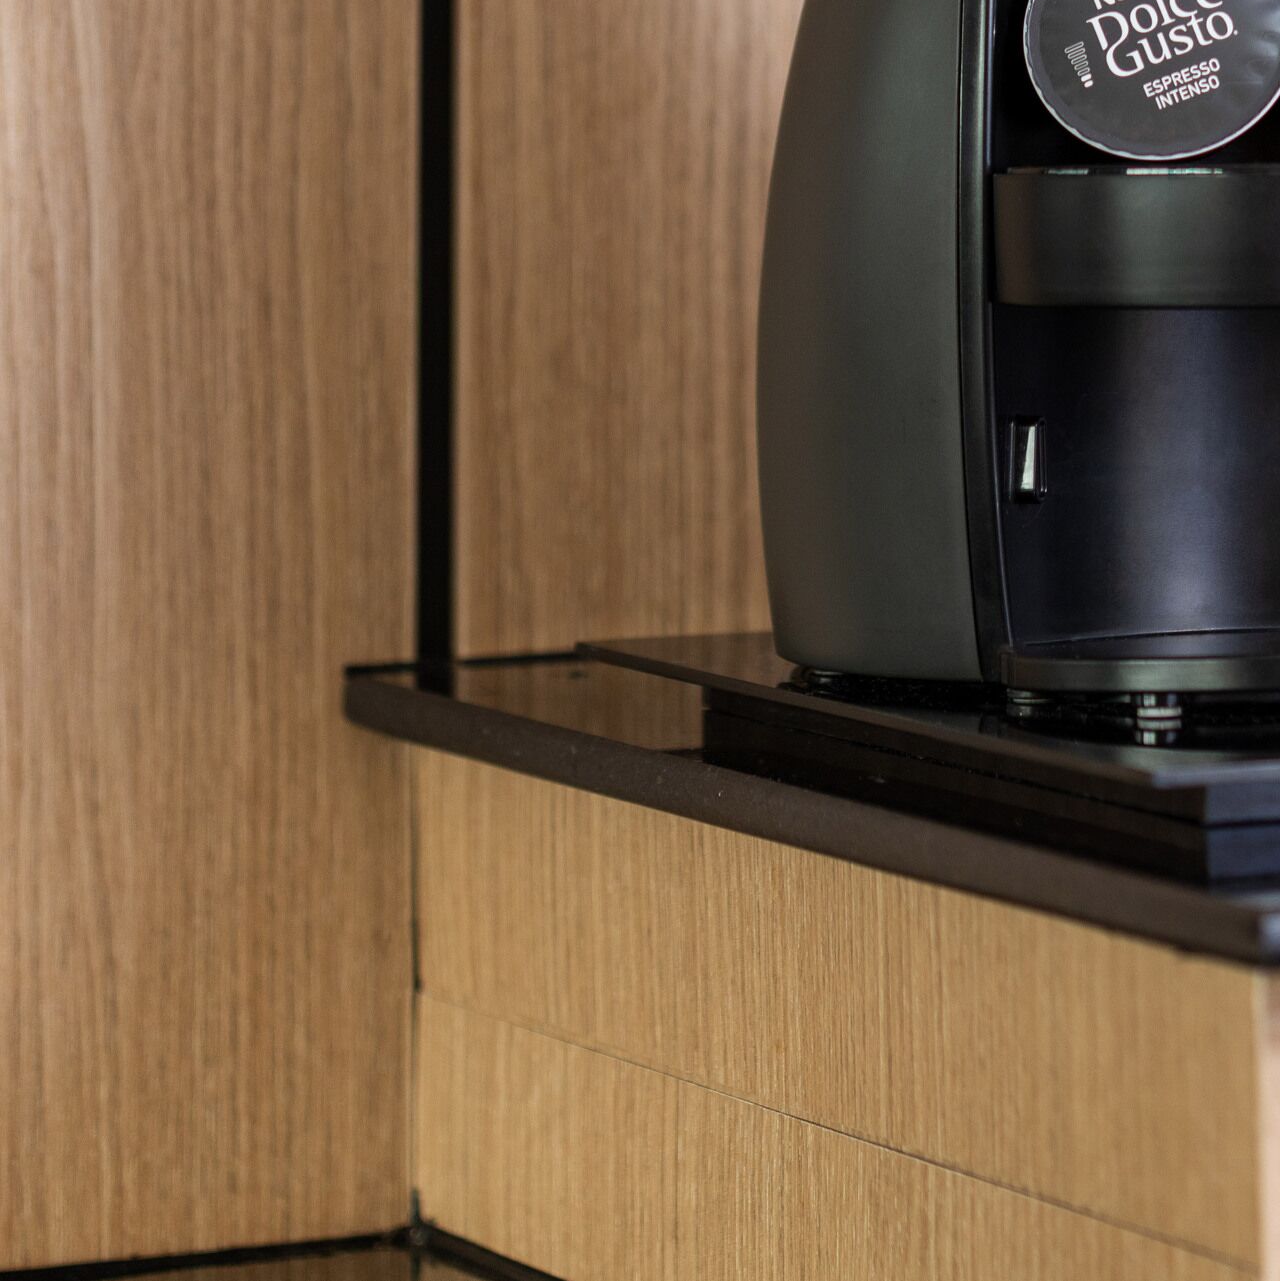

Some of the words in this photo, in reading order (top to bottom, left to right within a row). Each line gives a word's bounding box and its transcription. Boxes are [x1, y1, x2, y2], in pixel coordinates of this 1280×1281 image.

[1105, 11, 1236, 78] Gusto
[1143, 57, 1220, 98] ESPRESSO
[1154, 75, 1220, 111] INTENSO
